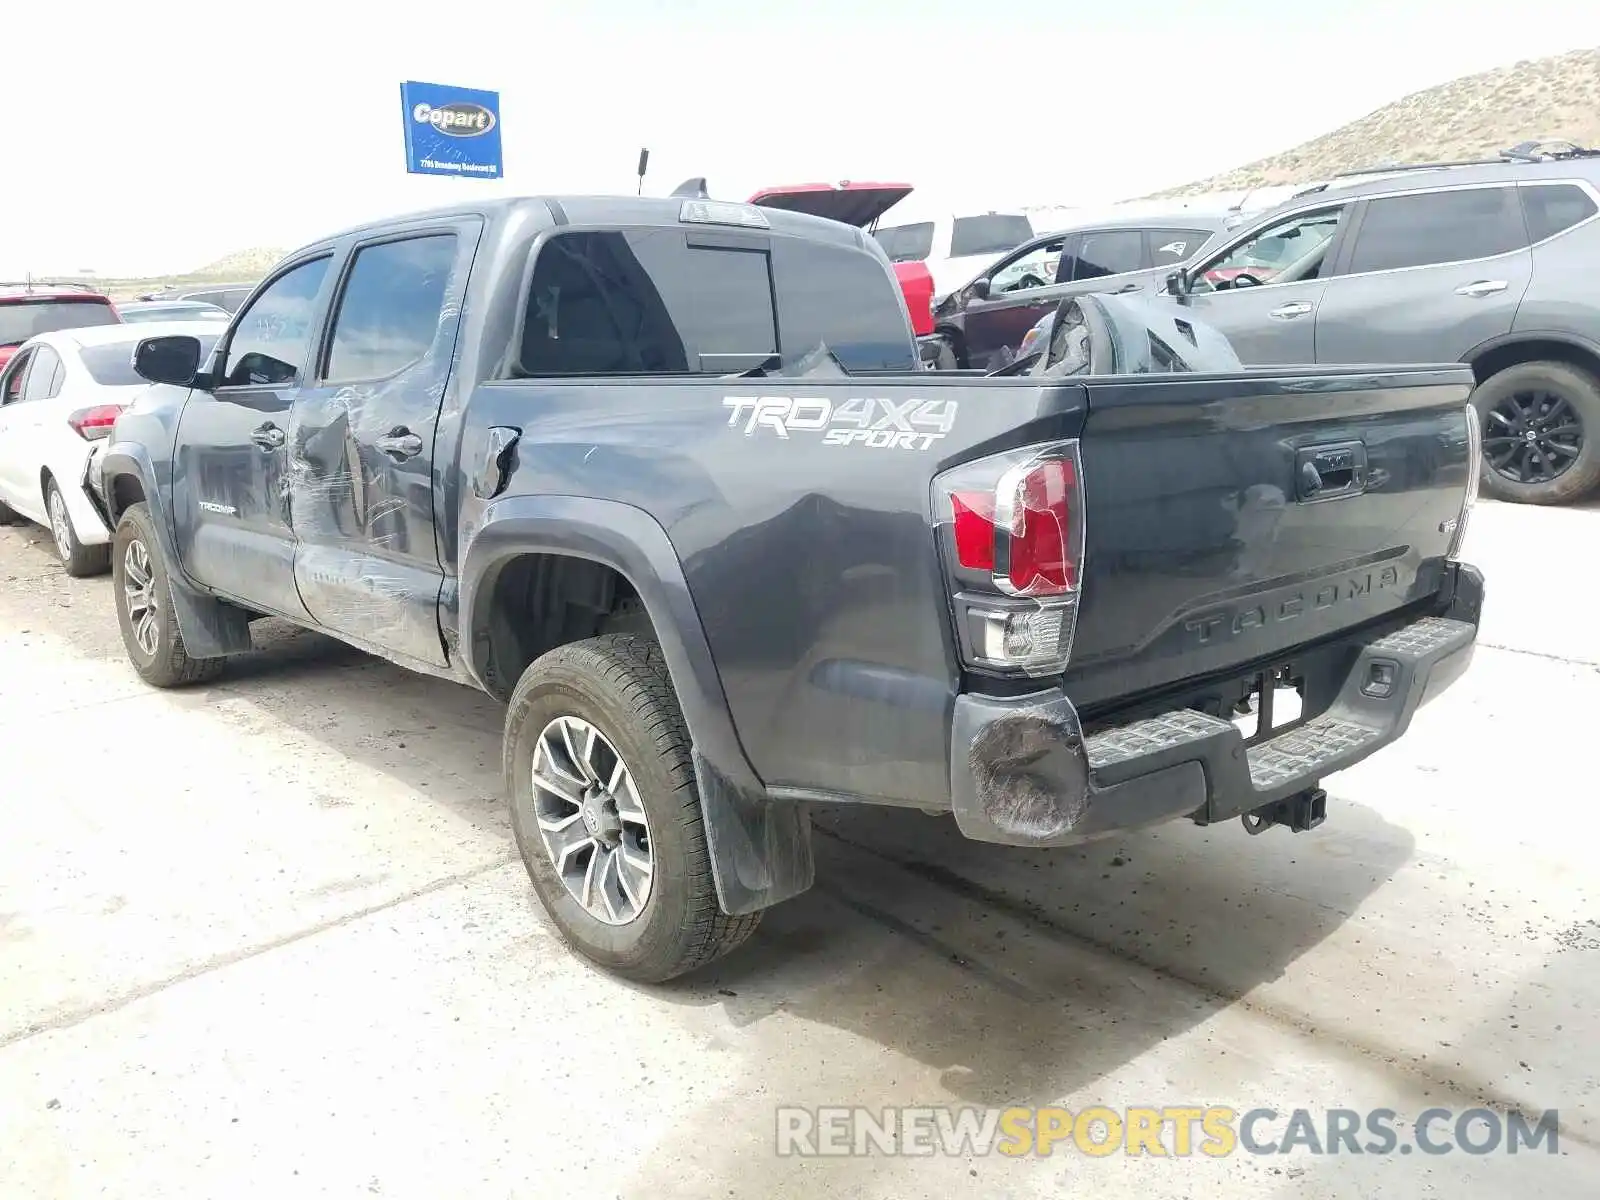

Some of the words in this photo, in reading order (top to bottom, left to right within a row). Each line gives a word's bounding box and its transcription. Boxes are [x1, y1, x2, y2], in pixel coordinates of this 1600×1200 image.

[413, 103, 486, 129] Copart
[822, 428, 947, 451] SPORT
[1185, 566, 1399, 644] TACOMA
